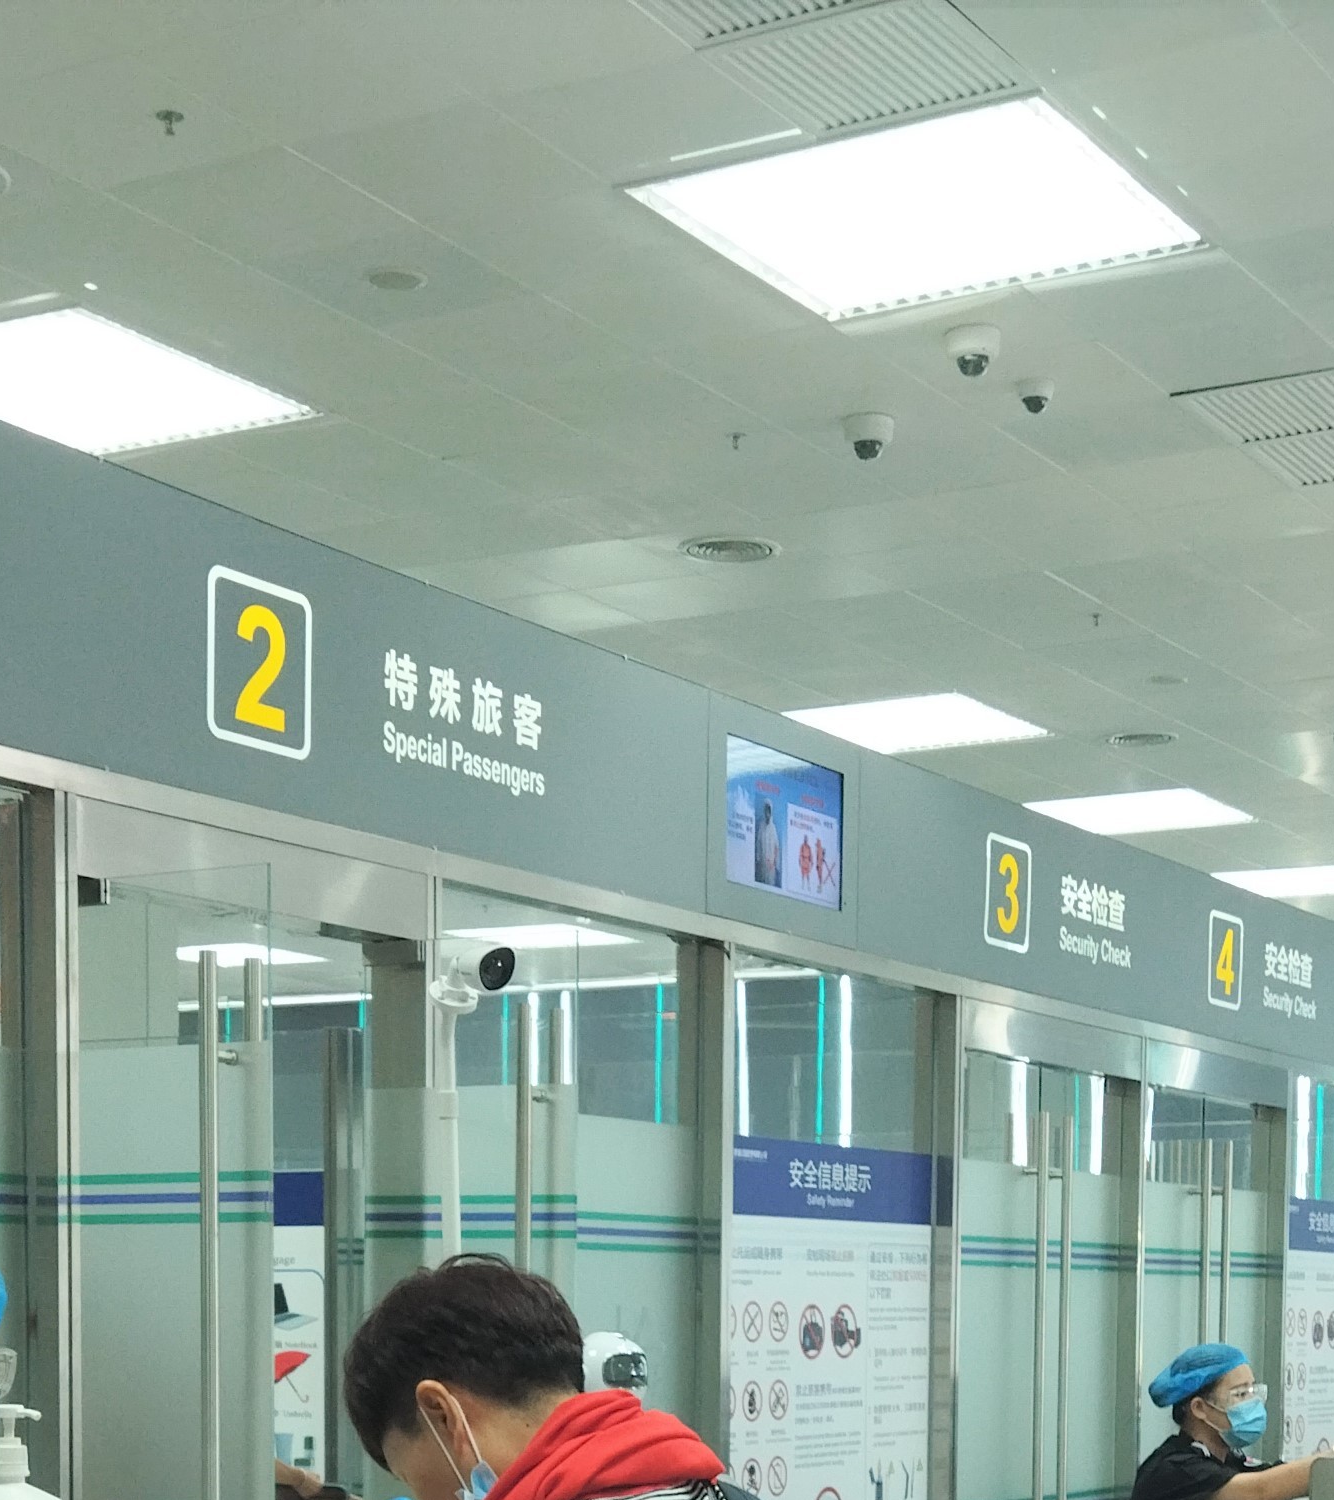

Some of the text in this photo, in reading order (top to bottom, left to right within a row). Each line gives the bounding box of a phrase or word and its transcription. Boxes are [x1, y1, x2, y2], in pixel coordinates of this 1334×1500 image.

[234, 604, 286, 733] 2
[384, 649, 542, 750] 特殊旅客
[383, 721, 545, 797] Special Passengers
[997, 853, 1019, 934] 3
[1061, 874, 1125, 932] 安全检查
[1059, 926, 1131, 968] Security Check
[1216, 928, 1234, 995] 4
[1264, 941, 1313, 989] 安全检查
[789, 1158, 872, 1194] 安全信息提示
